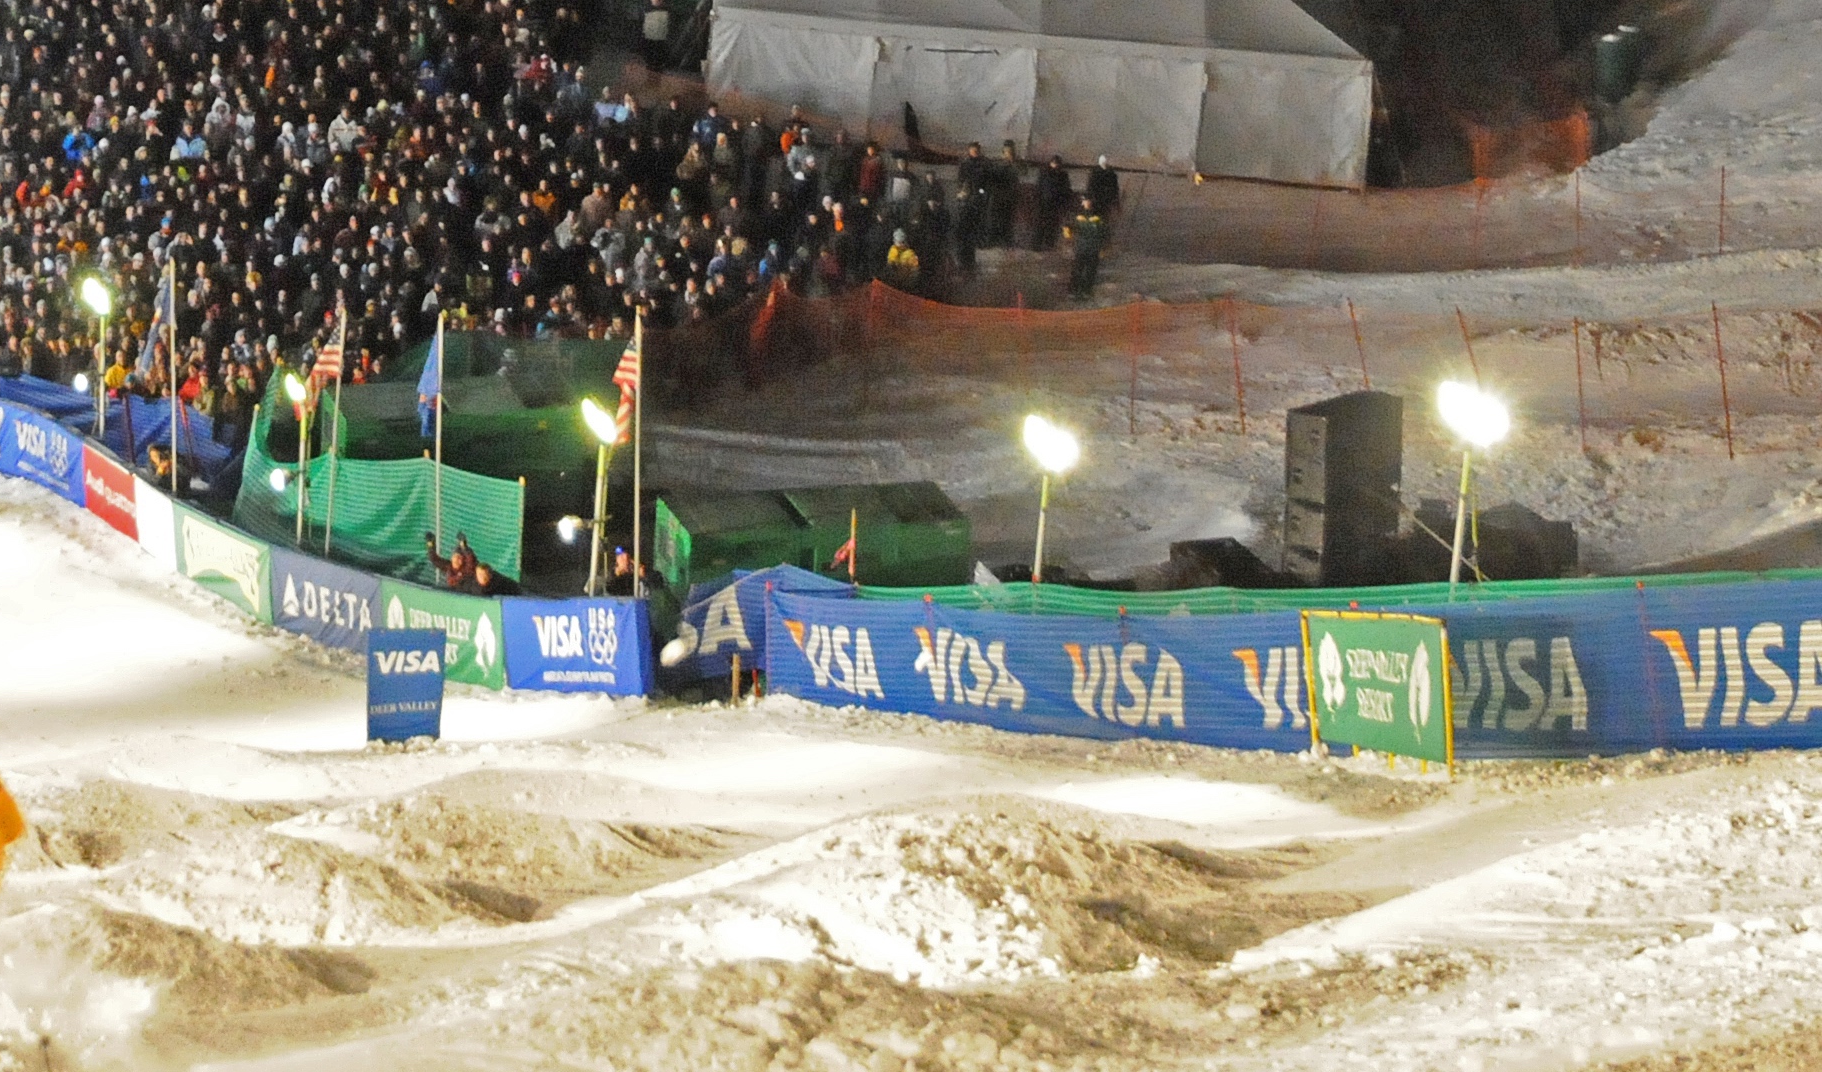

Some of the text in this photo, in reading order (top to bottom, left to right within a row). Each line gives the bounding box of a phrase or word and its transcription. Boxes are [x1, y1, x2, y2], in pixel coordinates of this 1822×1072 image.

[303, 580, 373, 632] DELTA
[588, 607, 616, 630] USA
[531, 614, 584, 658] VISA
[783, 619, 886, 699] VISA
[373, 649, 441, 674] VISA
[1063, 643, 1186, 728] VISA
[398, 700, 438, 713] VALLEY
[1232, 647, 1312, 729] VI
